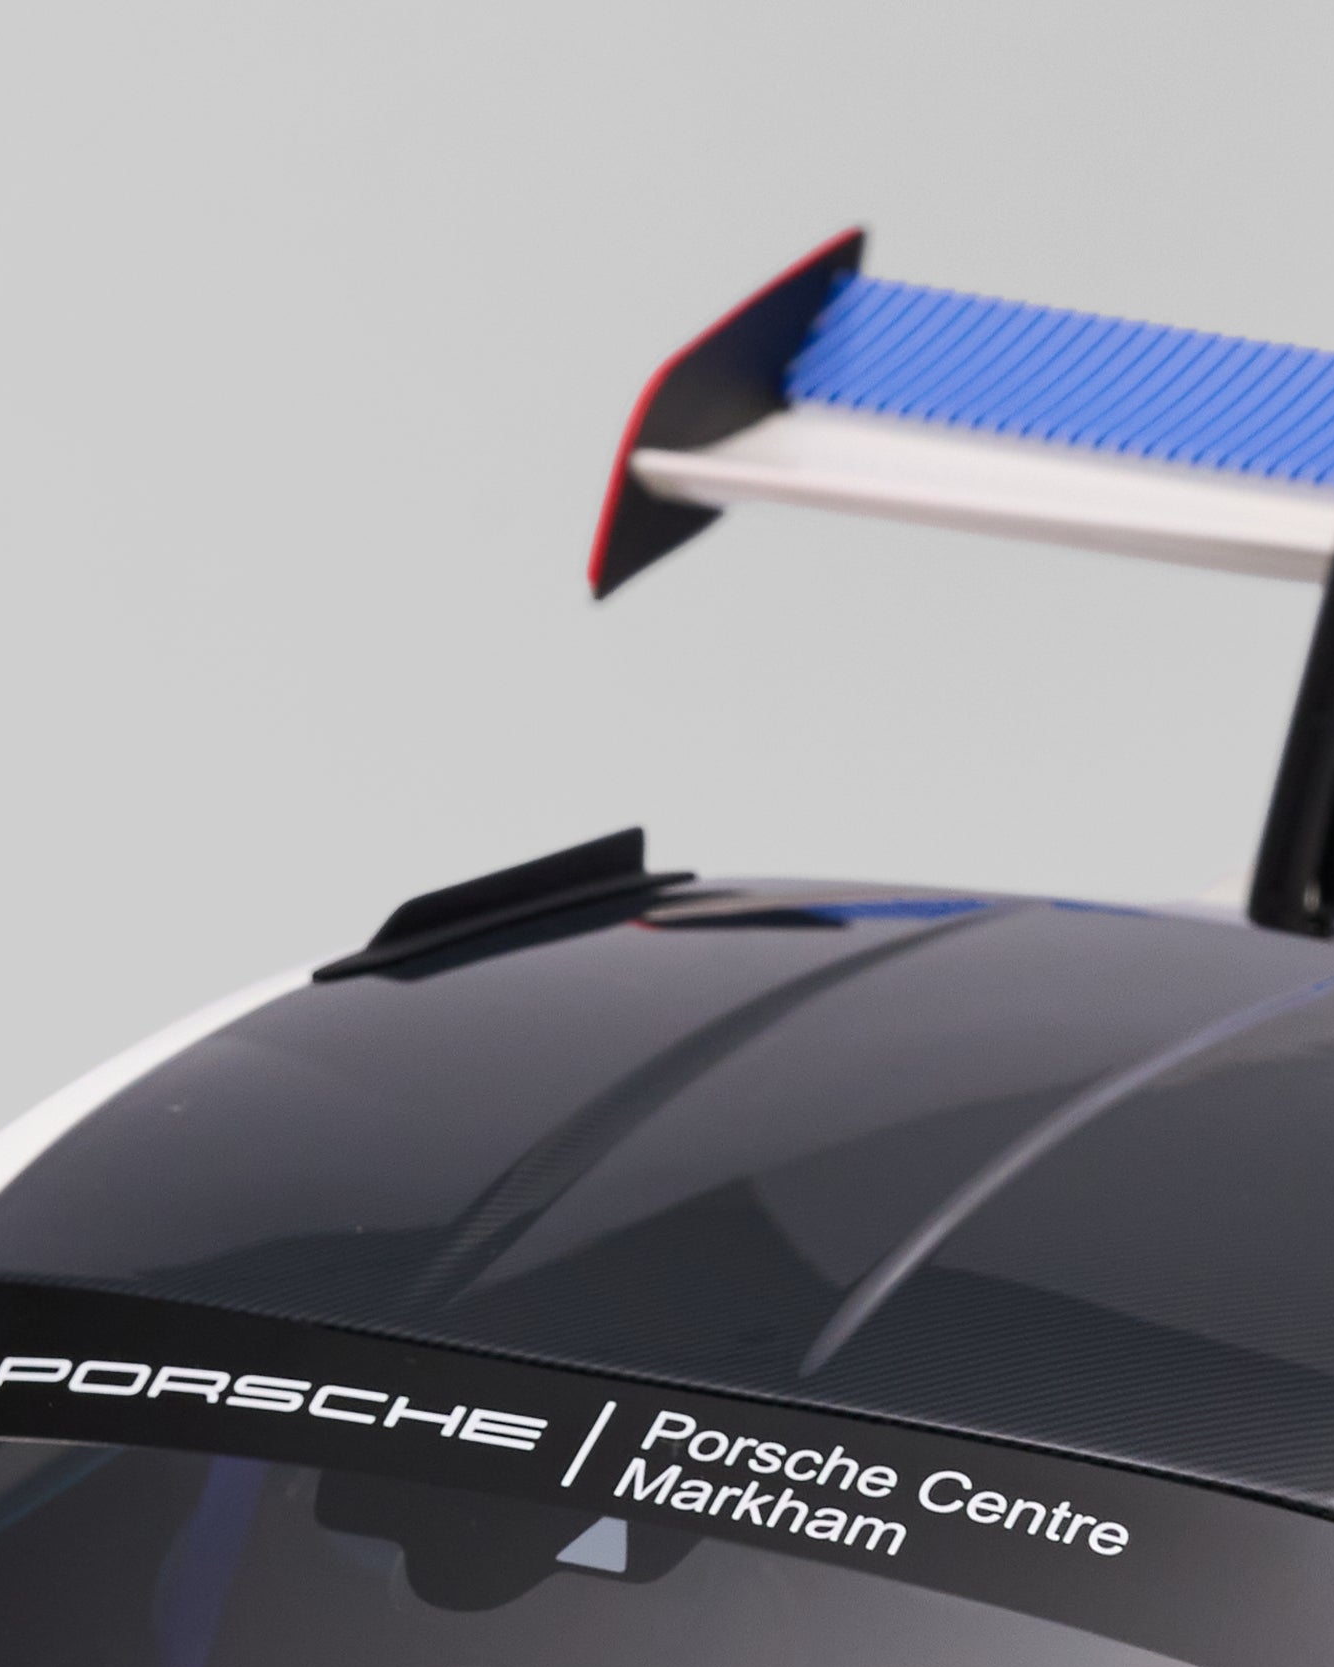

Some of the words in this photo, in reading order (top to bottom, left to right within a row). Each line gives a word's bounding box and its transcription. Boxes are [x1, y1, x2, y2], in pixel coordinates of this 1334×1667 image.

[613, 1457, 907, 1556] Markham
[641, 1410, 898, 1498] Porsche
[918, 1470, 1129, 1556] Centre
